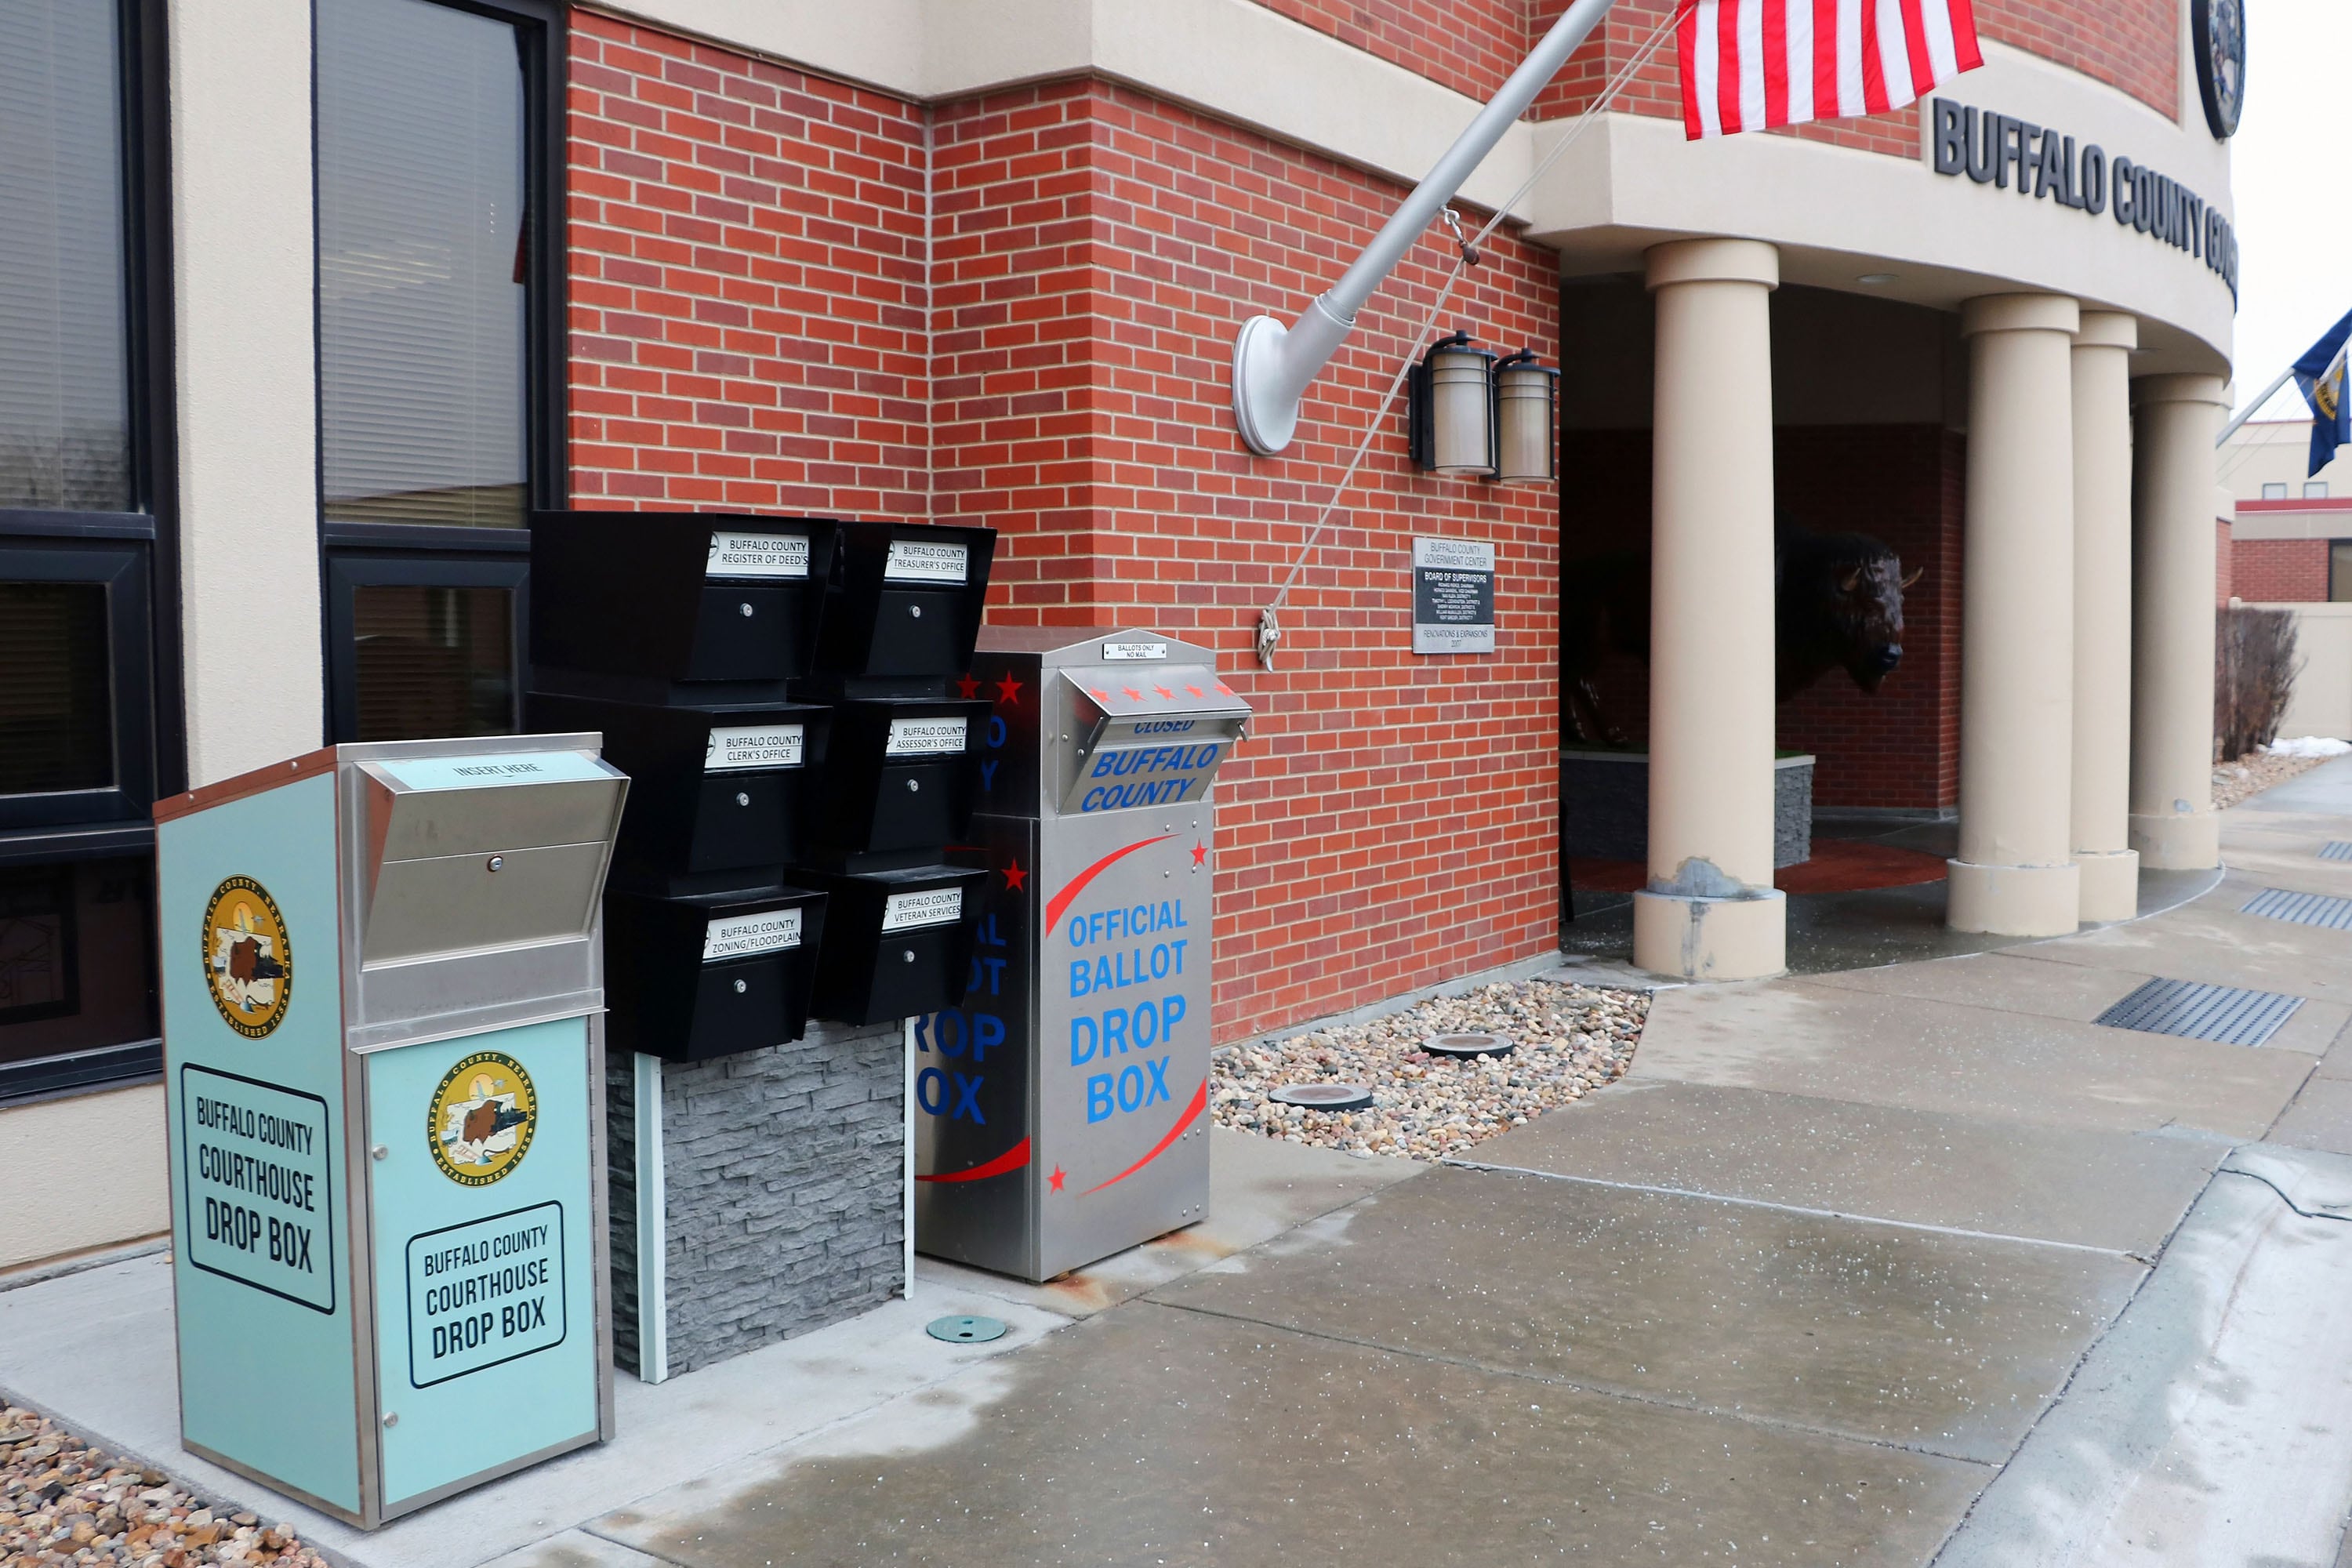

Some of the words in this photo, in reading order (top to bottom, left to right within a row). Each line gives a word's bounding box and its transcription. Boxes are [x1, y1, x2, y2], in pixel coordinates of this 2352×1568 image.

[1933, 97, 2107, 215] BUFFALO
[2113, 155, 2204, 257] COUNTY
[730, 539, 768, 550] BUFFALO
[771, 541, 807, 551] COUNTY
[903, 546, 935, 557] BUFFALO
[936, 549, 965, 558] COUNTY
[1431, 542, 1456, 554] BUFFALO
[1458, 544, 1481, 555] COUNTY
[722, 554, 763, 564] REGISTER
[765, 555, 776, 564] OF
[779, 555, 808, 565] DEED'S
[894, 558, 939, 569] TREASURER'S
[941, 561, 964, 571] OFFICE
[1425, 554, 1464, 565] GOVERNMENT
[1465, 556, 1486, 567] CENTER
[1425, 572, 1443, 581] BOARD
[1444, 572, 1451, 581] OF
[1452, 573, 1487, 583] SUPERVISORS
[1424, 630, 1456, 638] RENOVATIONS
[726, 736, 765, 747] BUFFALO
[767, 735, 802, 746] COUNTY
[903, 727, 935, 735] BUFFALO
[936, 726, 966, 735] COUNTY
[1134, 720, 1196, 735] CLOSED
[728, 750, 760, 760] CLERK'S
[762, 748, 790, 759] OFFICE
[896, 739, 938, 748] ASSESSOR'S
[939, 739, 963, 747] OFFICE
[452, 765, 504, 777] INSERT
[502, 763, 544, 774] HERE
[1091, 743, 1218, 779] BUFFALO
[1080, 777, 1197, 812] COUNTY
[894, 911, 927, 922] VETERAN
[928, 905, 960, 917] SERVICES
[897, 896, 930, 909] BUFFALO
[931, 892, 961, 905] COUNTY
[721, 924, 759, 938] BUFFALO
[760, 919, 795, 931] COUNTY
[1069, 898, 1188, 948] OFFICIAL
[203, 896, 218, 964] BUFFALO
[264, 896, 291, 980] NEBRASKA
[713, 931, 801, 953] ZONING/FLOODPLAIN
[1070, 938, 1188, 999] BALLOT
[209, 985, 267, 1037] ESTABLISHED
[1070, 994, 1186, 1067] DROP
[428, 1080, 449, 1142] BUFFALO
[507, 1060, 536, 1122] NEBRASKA
[916, 1066, 986, 1125] OX
[1087, 1055, 1171, 1124] BOX
[197, 1096, 255, 1139] BUFFALO
[258, 1112, 313, 1156] COUNTY
[436, 1158, 509, 1185] ESTABLISHED
[512, 1136, 532, 1166] 1855
[199, 1143, 315, 1212] COURTHOUSE
[205, 1196, 262, 1254] DROP
[268, 1216, 313, 1273] BOX
[425, 1240, 489, 1277] BUFFALO
[492, 1224, 548, 1258] COUNTY
[426, 1258, 549, 1316] COURTHOUSE
[433, 1312, 494, 1359] DROP
[502, 1295, 546, 1338] BOX
